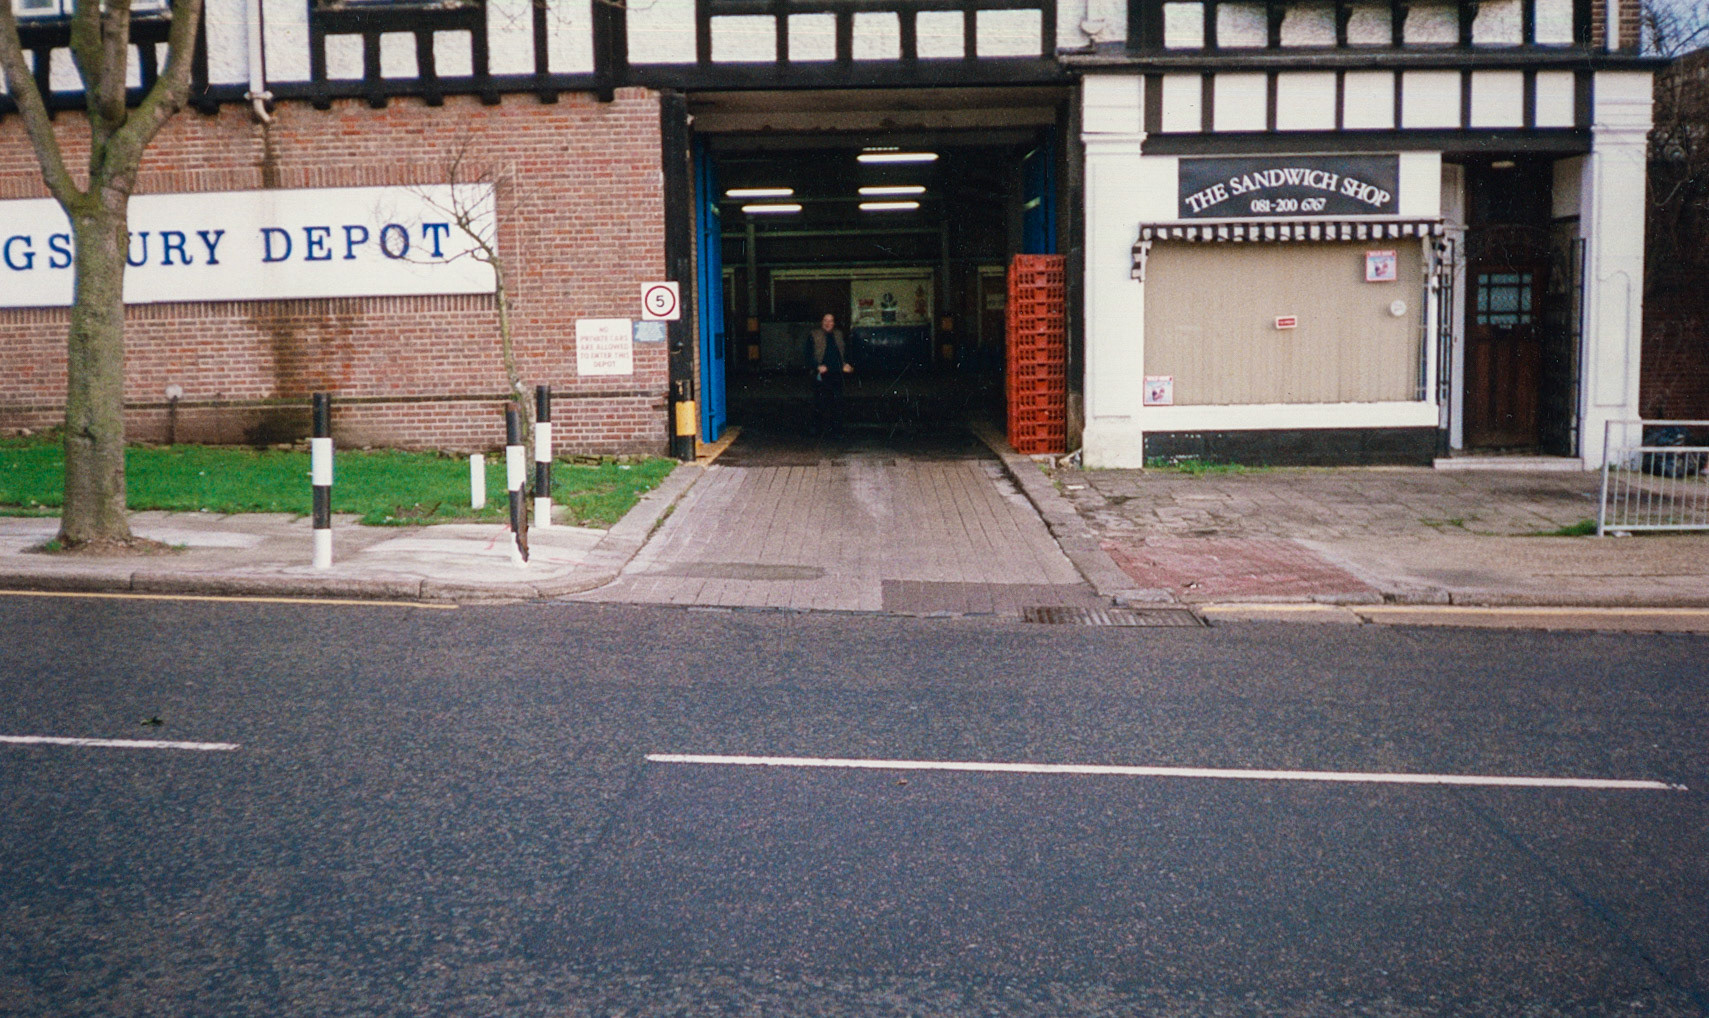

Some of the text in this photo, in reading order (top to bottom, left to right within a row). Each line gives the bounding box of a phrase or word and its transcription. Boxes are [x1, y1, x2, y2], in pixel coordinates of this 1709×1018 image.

[1185, 167, 1391, 213] THE SANDWICH SHOP
[1251, 197, 1327, 212] 081-200 6767
[3, 223, 450, 271] GSURY DEPOT
[656, 295, 665, 307] 5
[593, 360, 616, 368] DEPOT
